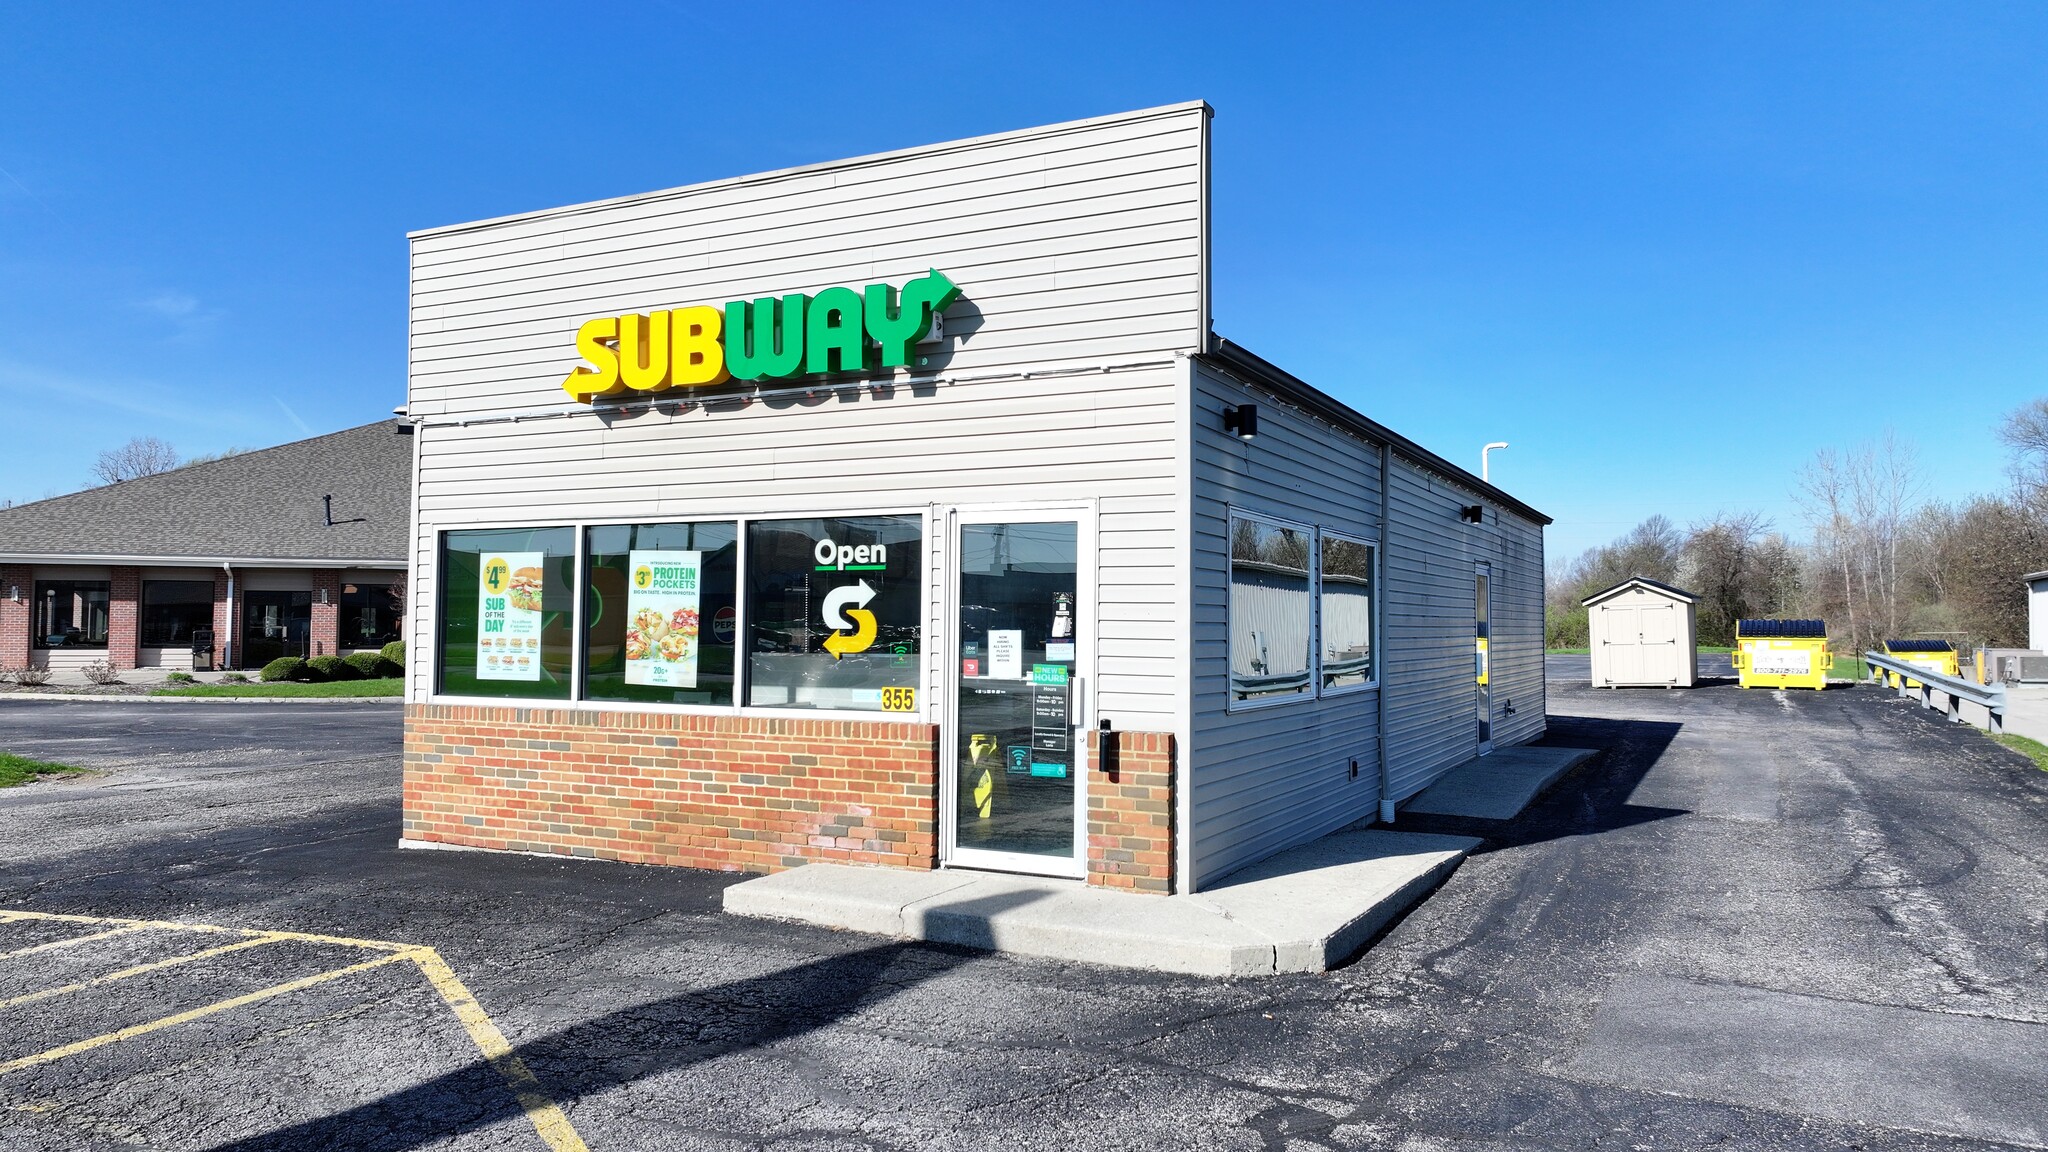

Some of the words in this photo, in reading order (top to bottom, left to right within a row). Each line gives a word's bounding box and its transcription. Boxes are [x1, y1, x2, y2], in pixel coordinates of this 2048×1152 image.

[562, 268, 962, 404] SUBWAY
[814, 538, 887, 571] Open
[653, 567, 696, 579] PROTEIN
[653, 580, 696, 589] POCKETS
[485, 597, 505, 611] SUB
[485, 620, 504, 632] DAY
[1035, 674, 1065, 682] HOURS
[883, 689, 914, 709] 355
